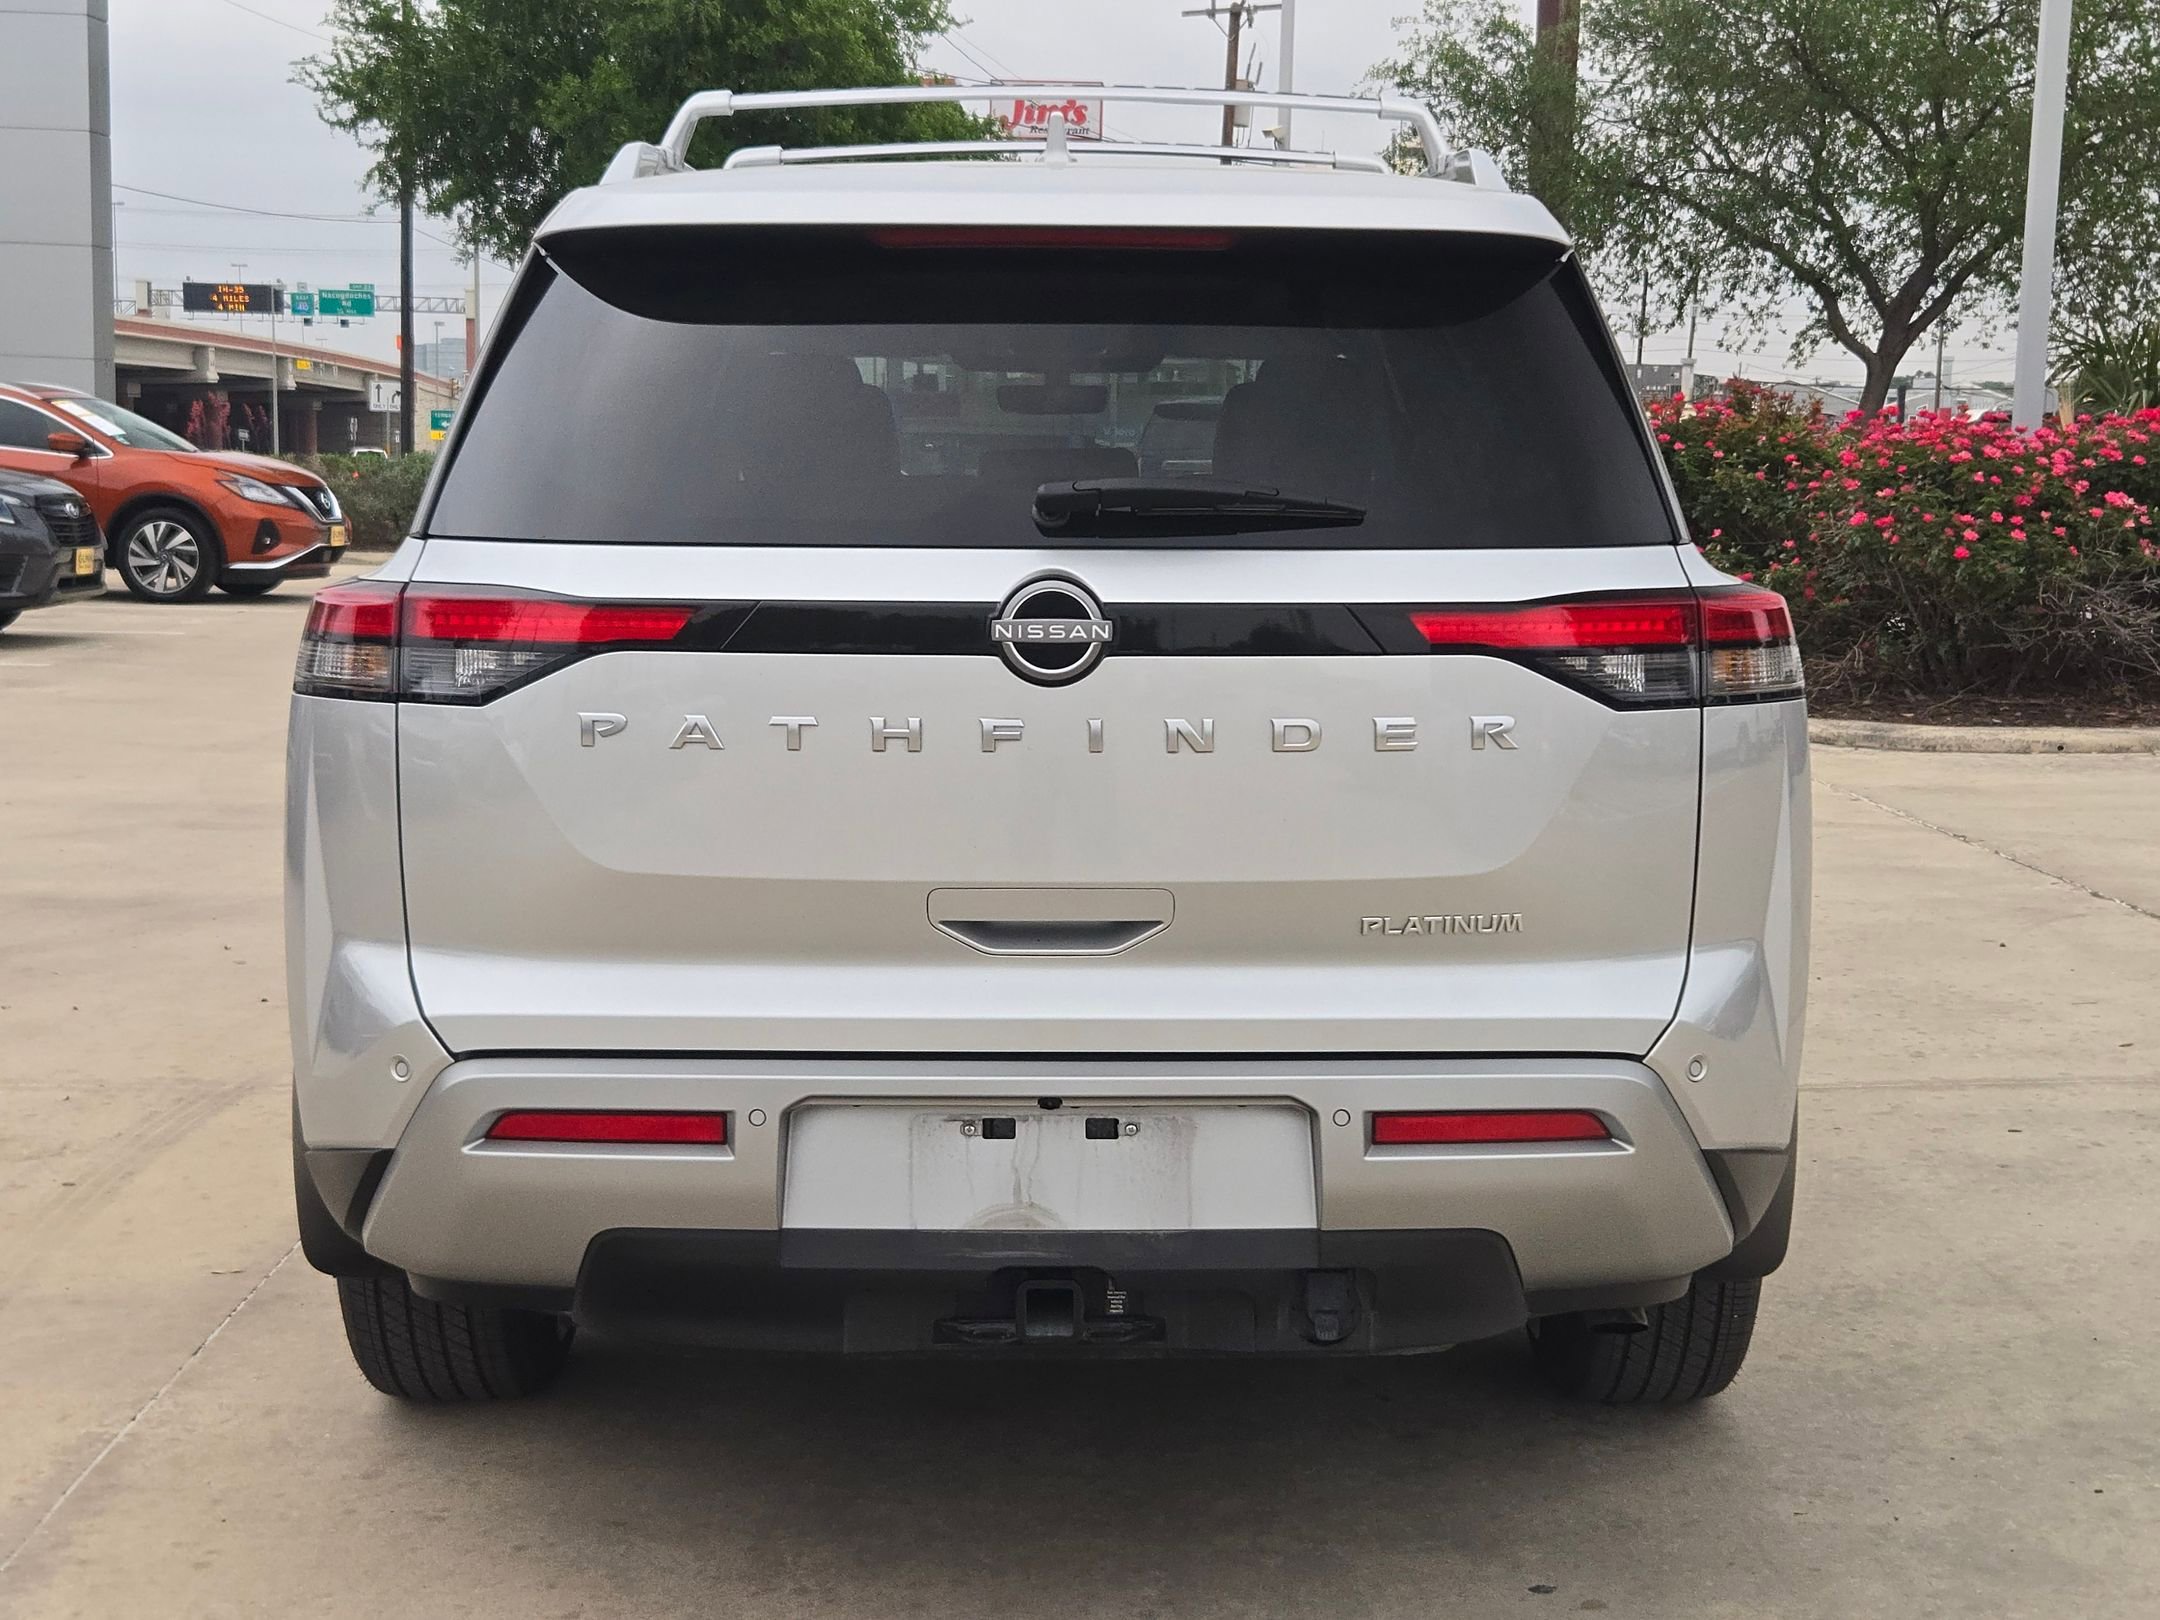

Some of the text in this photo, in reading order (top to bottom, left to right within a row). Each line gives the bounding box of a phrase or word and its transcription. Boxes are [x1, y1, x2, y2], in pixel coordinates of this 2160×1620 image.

[223, 295, 250, 303] MILES
[228, 303, 246, 312] MIN
[994, 624, 1110, 639] NISSAN
[576, 711, 1520, 753] PATHFINDER
[1360, 912, 1525, 936] PLATINUM
